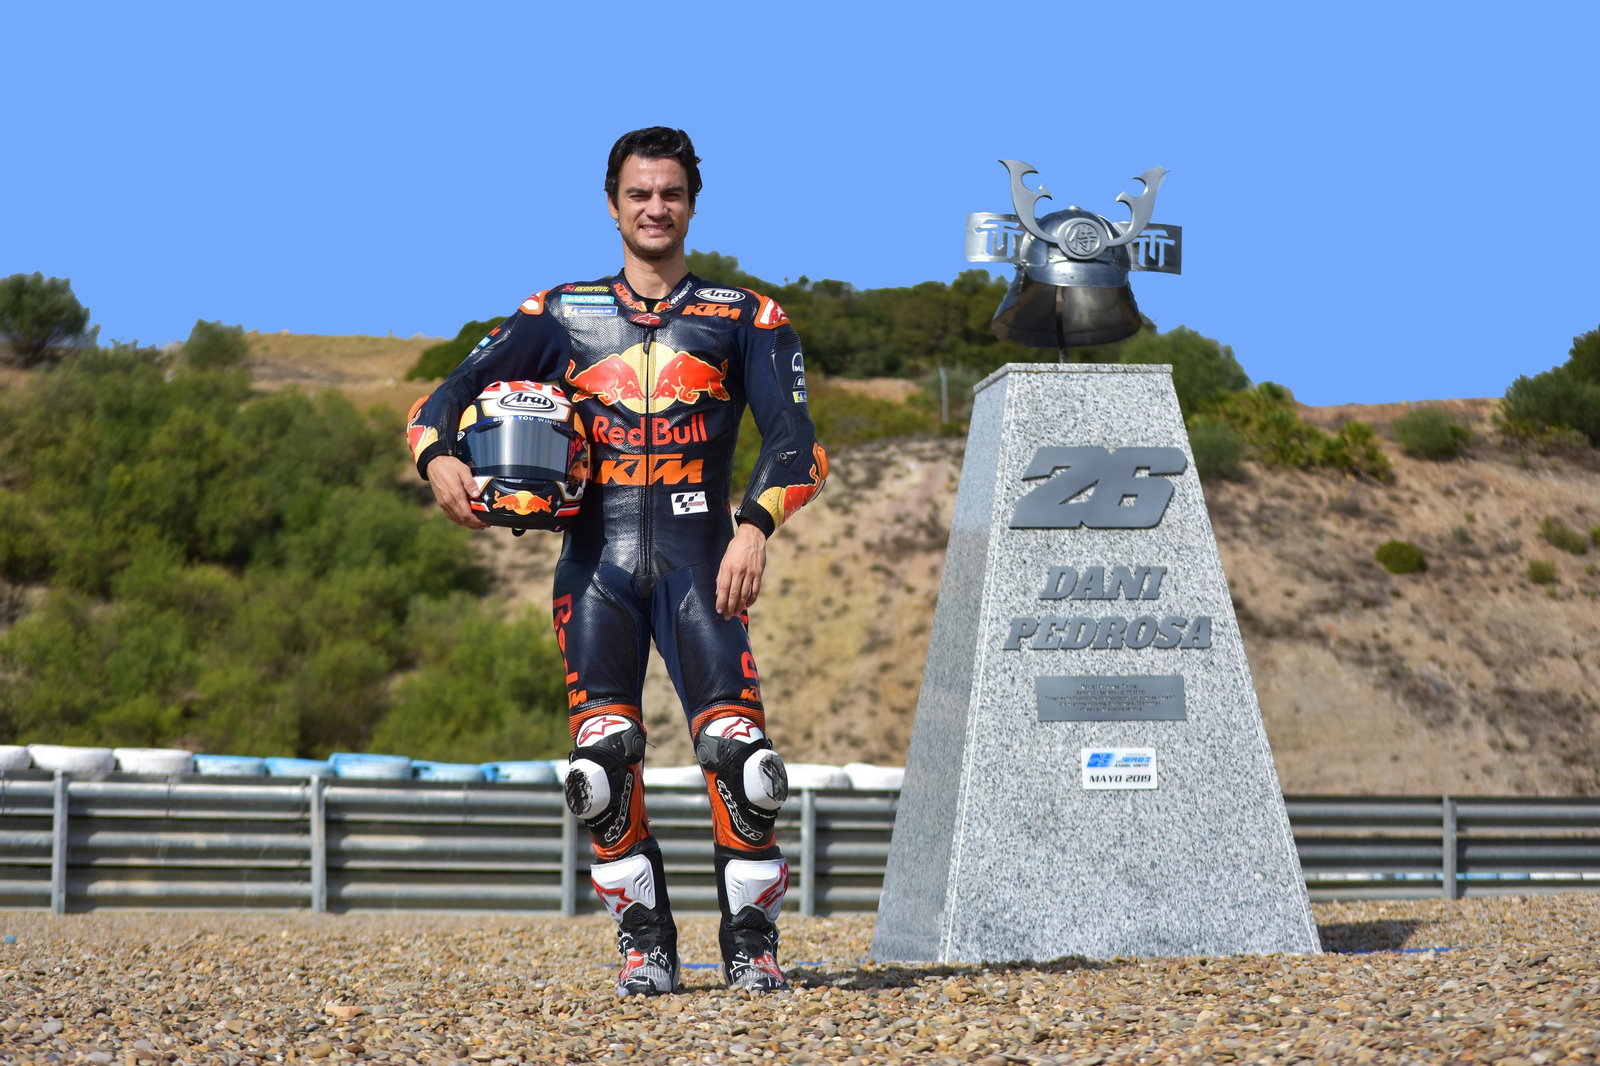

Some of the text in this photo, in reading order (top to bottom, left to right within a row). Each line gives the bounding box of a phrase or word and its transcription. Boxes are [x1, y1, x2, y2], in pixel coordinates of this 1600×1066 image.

[574, 295, 612, 303] MOTOREX
[613, 282, 635, 306] KTM
[701, 289, 738, 299] Arai
[681, 302, 742, 321] KTM
[504, 392, 550, 406] Arai
[537, 417, 561, 427] WINGS
[592, 412, 708, 447] Red Bull
[594, 453, 705, 486] KTM
[1009, 446, 1188, 530] 26
[1037, 565, 1168, 601] DANI
[1001, 615, 1213, 651] PEDROSA
[1089, 774, 1152, 783] MAYO 2019
